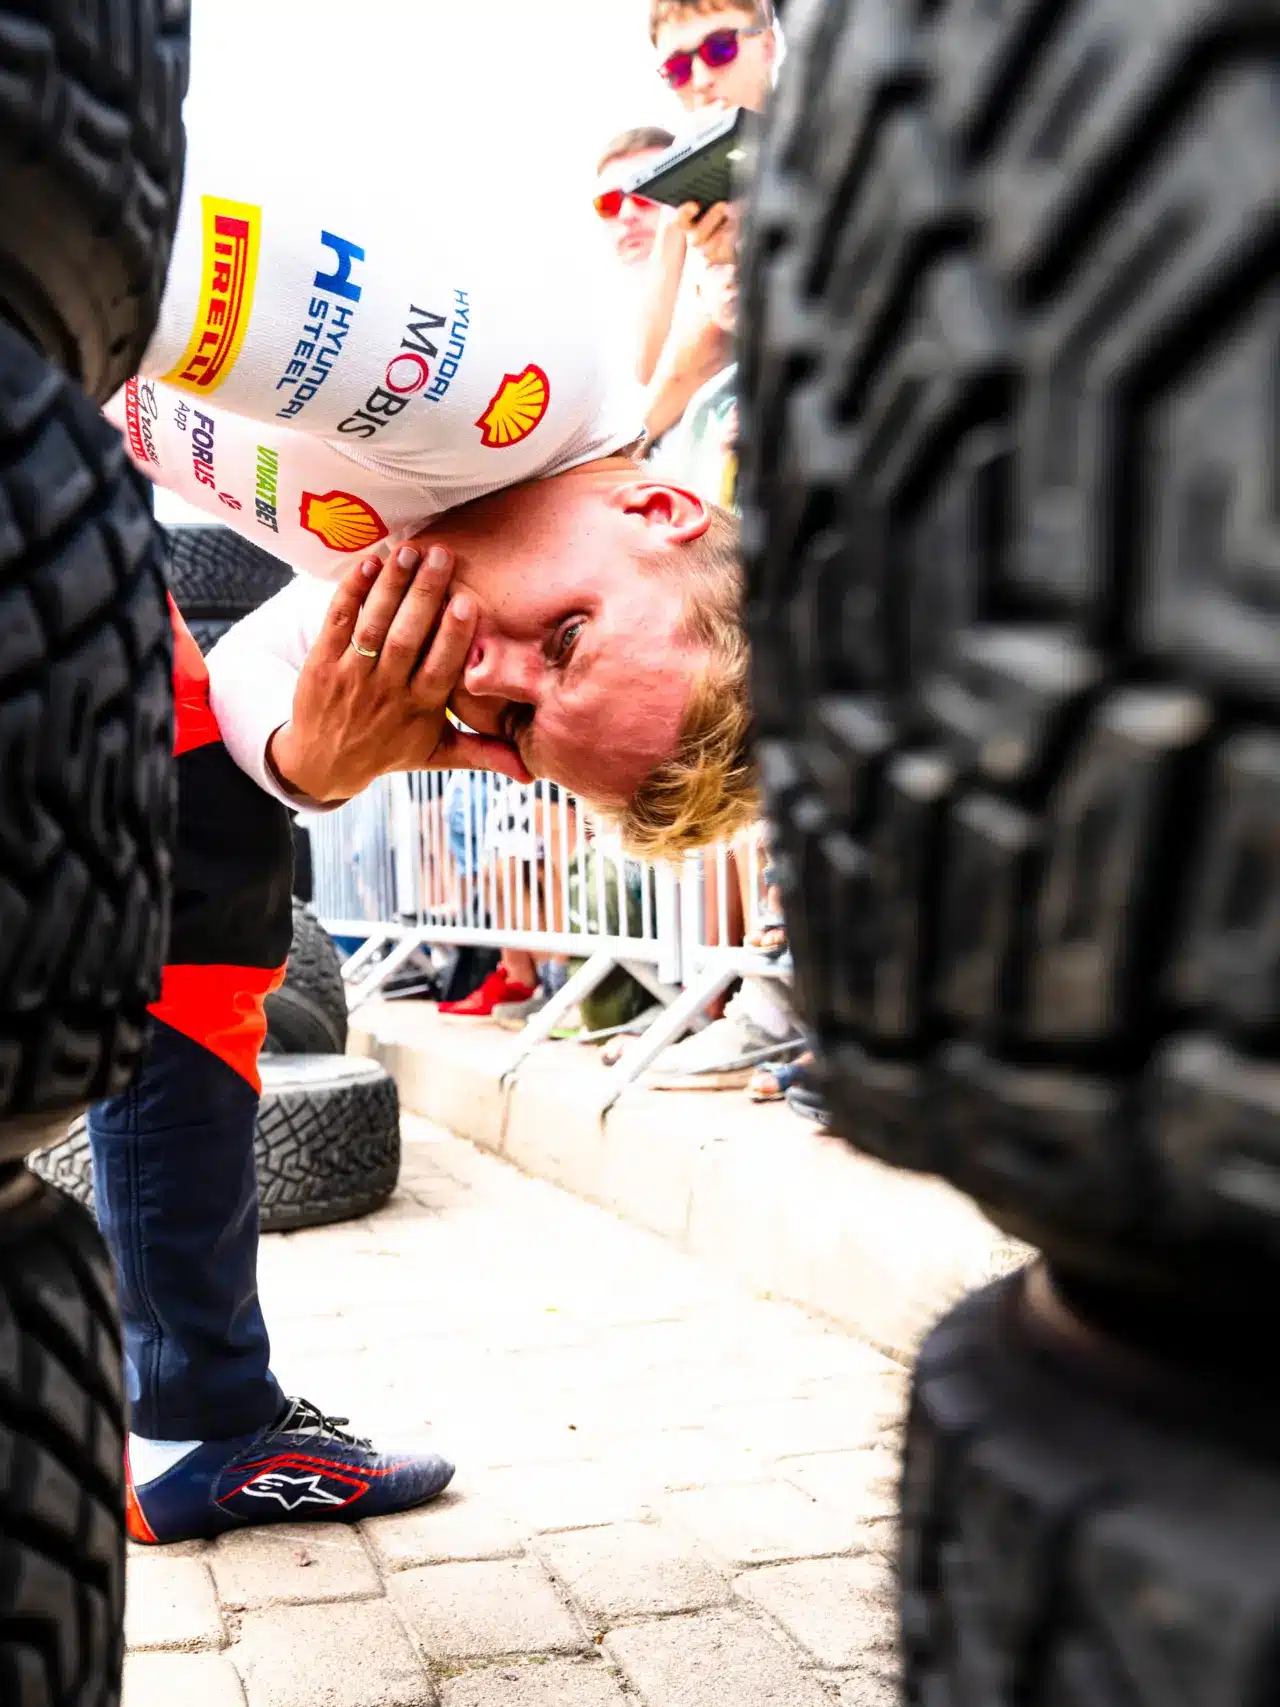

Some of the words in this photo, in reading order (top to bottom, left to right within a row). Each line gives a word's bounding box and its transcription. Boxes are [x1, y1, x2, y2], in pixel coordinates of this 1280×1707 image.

[179, 214, 250, 386] PIRELLI
[275, 297, 317, 390] STEEL
[424, 288, 469, 402] HYUNDAI
[275, 304, 355, 420] HYUNDAI
[336, 303, 448, 439] MOBIS
[174, 399, 191, 432] App
[192, 410, 216, 491] FORUS
[255, 444, 279, 534] VIVATBET
